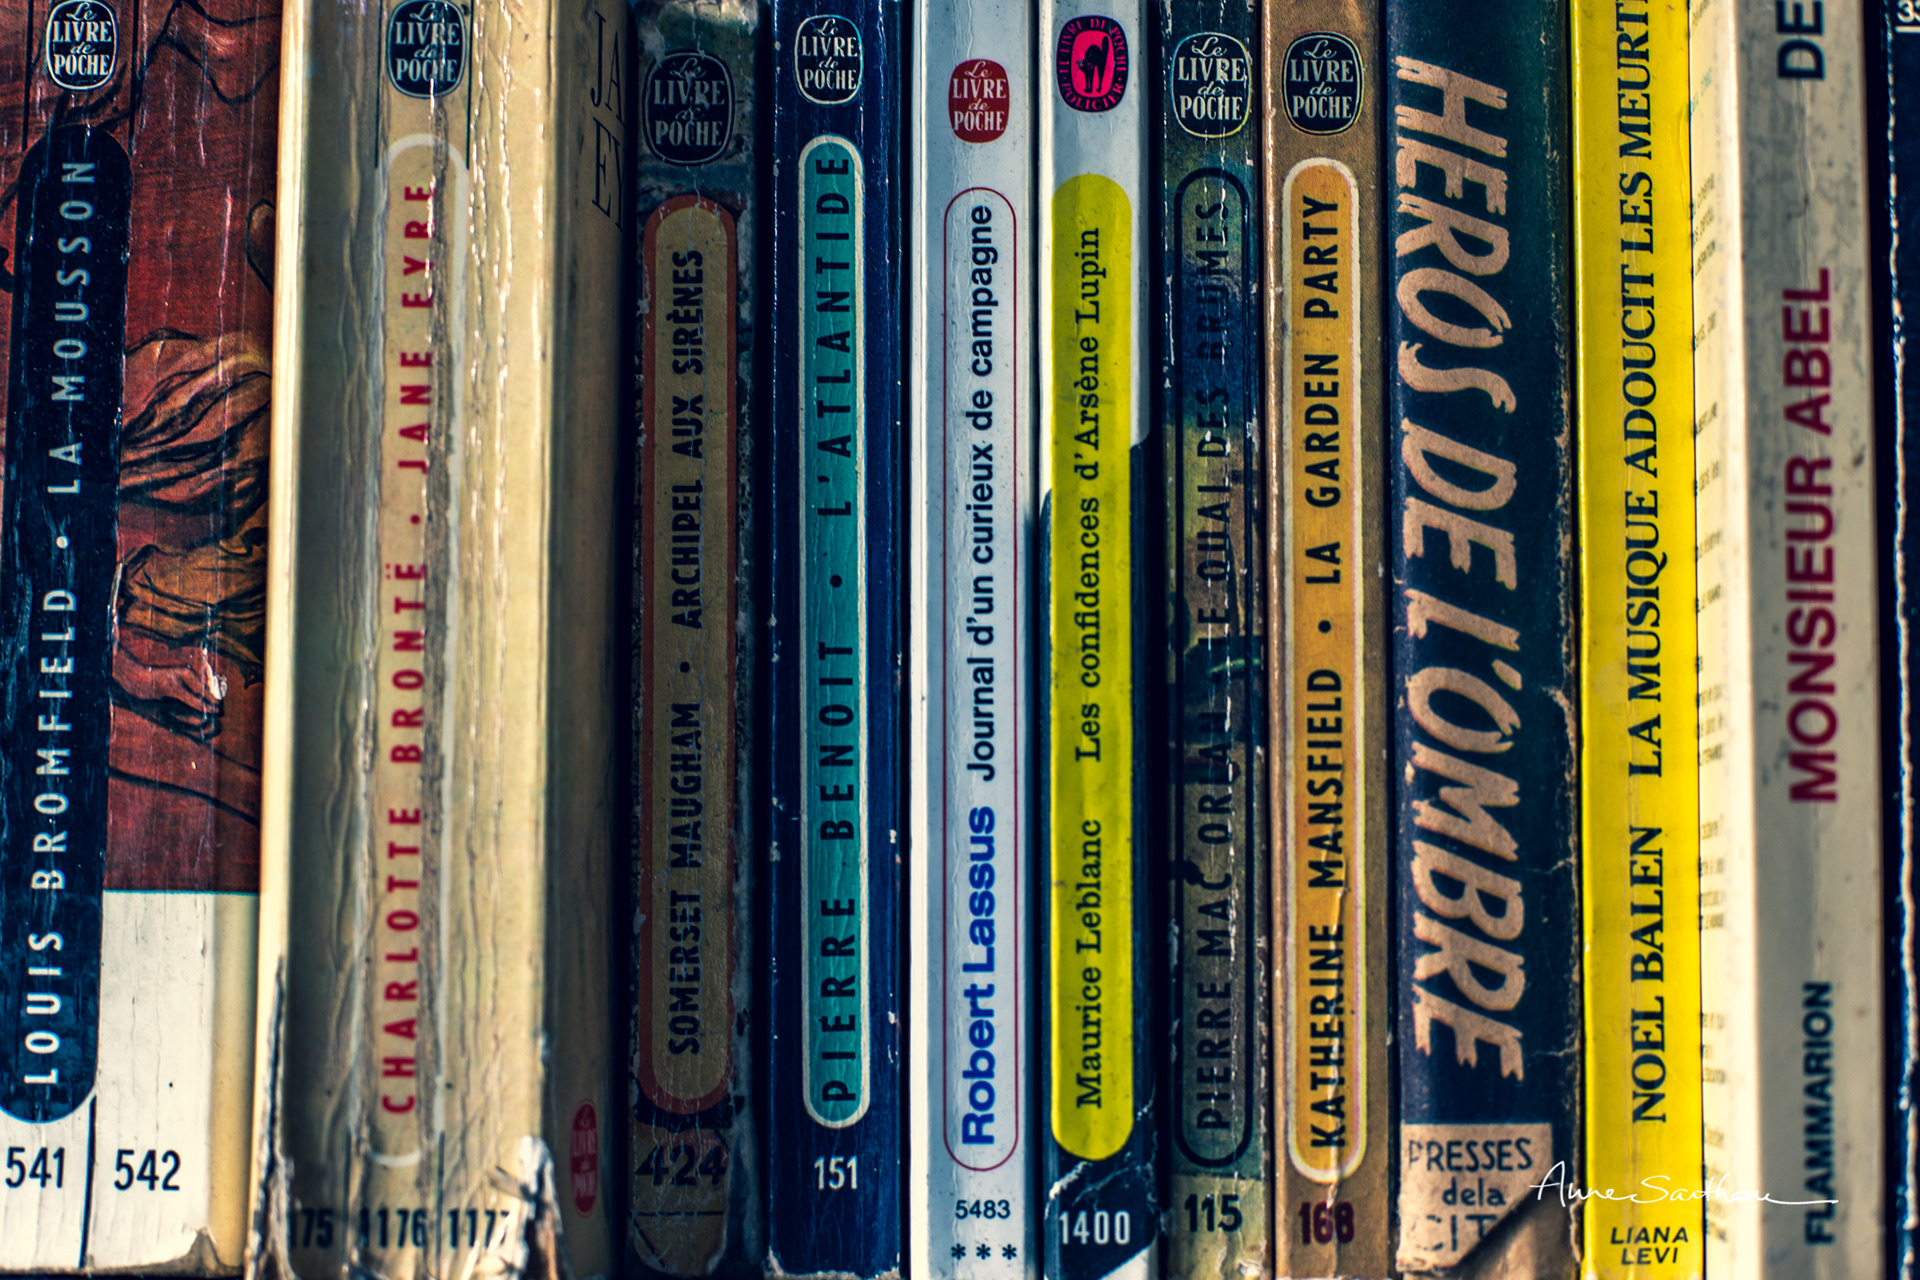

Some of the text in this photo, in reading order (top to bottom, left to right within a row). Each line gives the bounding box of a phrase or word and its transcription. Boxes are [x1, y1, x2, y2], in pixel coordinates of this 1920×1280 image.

[66, 2, 97, 20] Le
[53, 21, 112, 42] LIVRE
[395, 22, 460, 45] LIVRE
[814, 18, 839, 36] Le
[70, 41, 96, 54] de
[802, 36, 858, 57] LIVRE
[1191, 36, 1227, 57] Le
[1303, 40, 1337, 59] Le
[1776, 0, 1825, 81] DE
[54, 54, 109, 75] POCHE
[395, 59, 458, 82] POCHE
[669, 57, 707, 79] Le
[818, 56, 839, 69] de
[964, 61, 993, 78] Le
[1178, 57, 1246, 82] LIVRE
[1290, 59, 1354, 83] LIVRE
[804, 69, 857, 90] POCHE
[953, 79, 1006, 99] LIVRE
[1197, 81, 1226, 96] de
[1310, 81, 1337, 96] de
[653, 80, 725, 105] LIVRE
[968, 98, 991, 111] de
[1061, 82, 1124, 110] POLICIER
[675, 107, 705, 120] de
[1180, 95, 1243, 120] POCHE
[1292, 95, 1352, 119] POCHE
[655, 120, 723, 146] POCHE
[954, 111, 1005, 131] POCHE
[1194, 203, 1229, 360] BRUMES
[815, 158, 851, 517] L'ATLANTIDE
[1196, 387, 1230, 457] DES
[1195, 485, 1231, 582] QUAI
[1782, 267, 1839, 804] MONSIEUR ABEL
[1394, 54, 1527, 1082] HEROS DE L'OMBRE
[1615, 0, 1668, 1124] NOEL BALEN LA MUSIQUE ADOUCIT LES MEURT
[24, 162, 95, 1085] LOUIS BROMFIELD LA MOUSSON
[381, 185, 435, 1115] CHARLOTTE BRONTË JANE EYRE
[666, 250, 704, 1056] SOMERSET MAUGHAM ARCHIPEL AUX SIRÈNES
[961, 204, 999, 1146] Robert Lassus Journal d'un curieux de campagne
[1072, 227, 1107, 1109] Maurice Leblanc Les confidences d'Arsène Lupin
[1302, 195, 1346, 1148] KATHERINE MANSFIELD LA GARDEN PARTY
[818, 641, 856, 841] BENOIT
[1198, 871, 1231, 957] MAC
[1197, 981, 1232, 1130] PIERRE
[1803, 980, 1837, 1246] FLAMMARION
[634, 1144, 727, 1186] 424
[1409, 1137, 1533, 1172] PRESSES
[5, 1146, 181, 1191] 541 542
[813, 1156, 859, 1190] 151
[955, 1199, 1011, 1220] 5483
[1184, 1194, 1243, 1233] 115
[359, 1208, 428, 1249] 1176
[1059, 1210, 1131, 1245] 1400
[1299, 1201, 1355, 1246] 168
[1610, 1226, 1689, 1245] LIANA
[1621, 1246, 1679, 1265] LEVI
